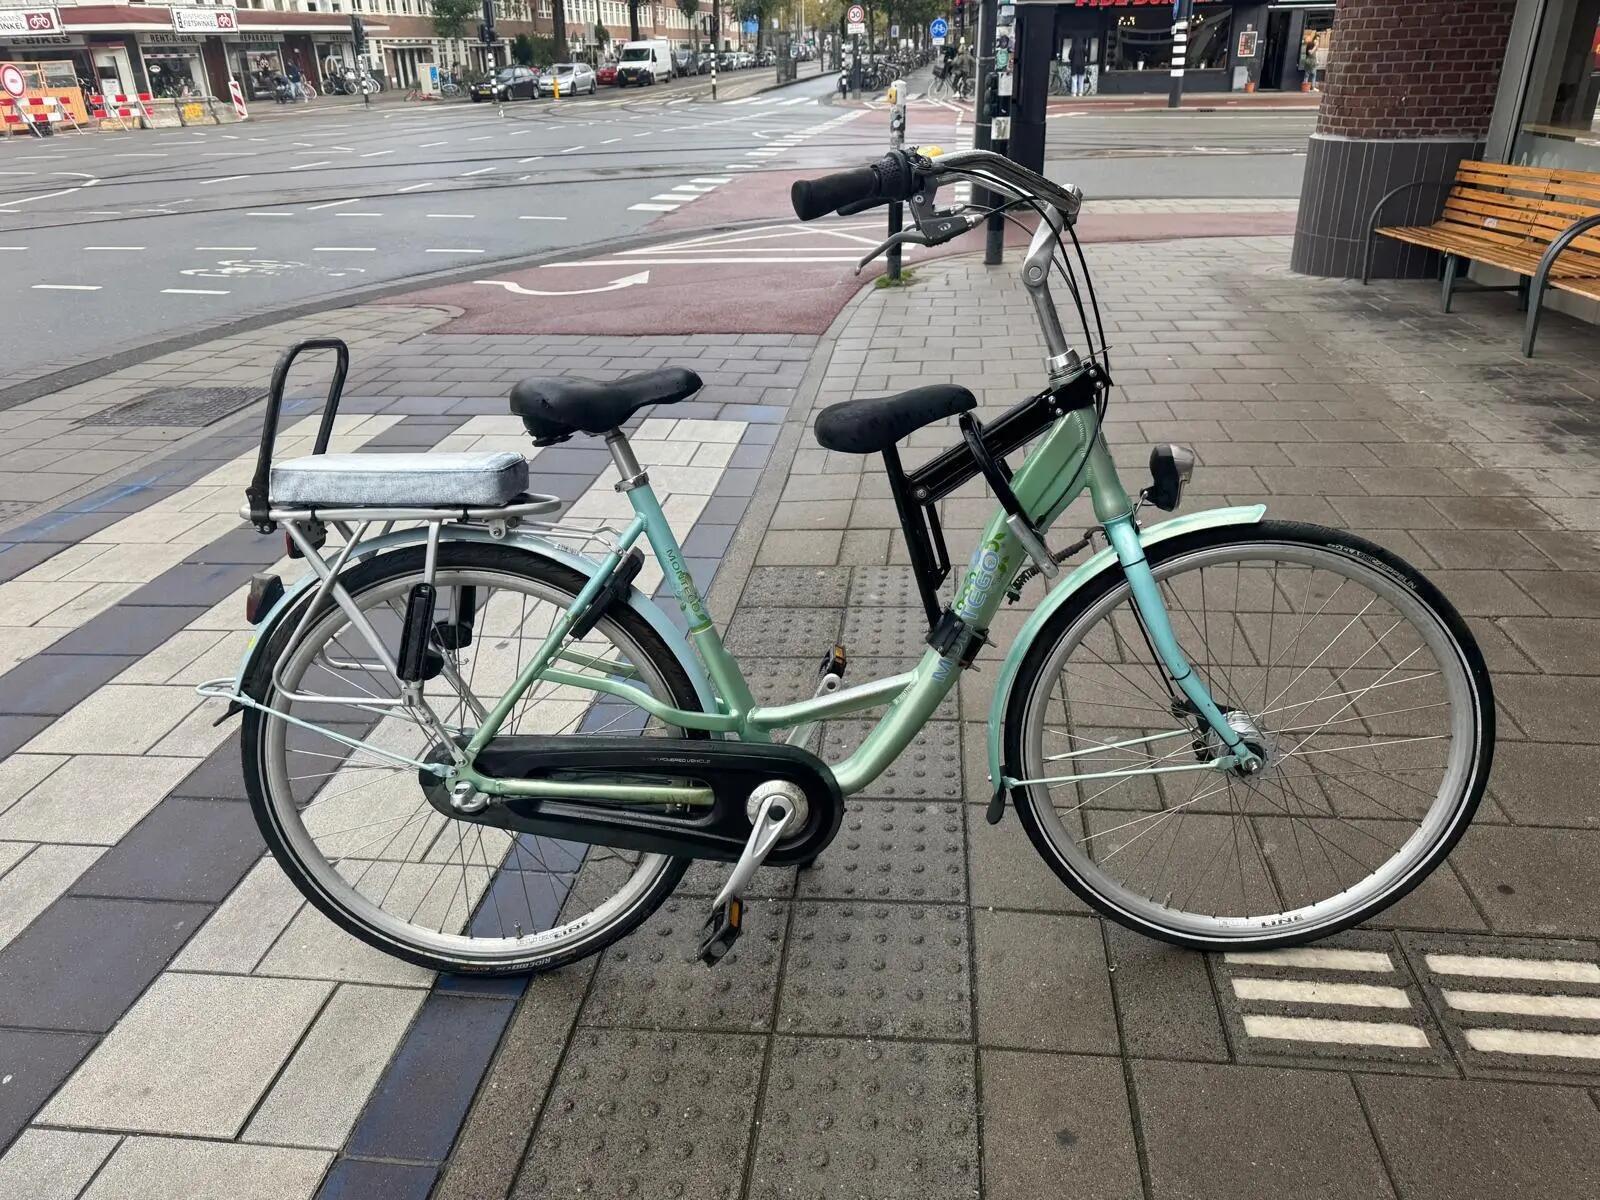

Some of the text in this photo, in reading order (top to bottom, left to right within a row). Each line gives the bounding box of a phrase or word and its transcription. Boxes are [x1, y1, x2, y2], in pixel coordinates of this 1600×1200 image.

[851, 11, 861, 19] 30
[11, 36, 71, 45] E-BIKES
[1376, 558, 1417, 589] ZEPPELIN
